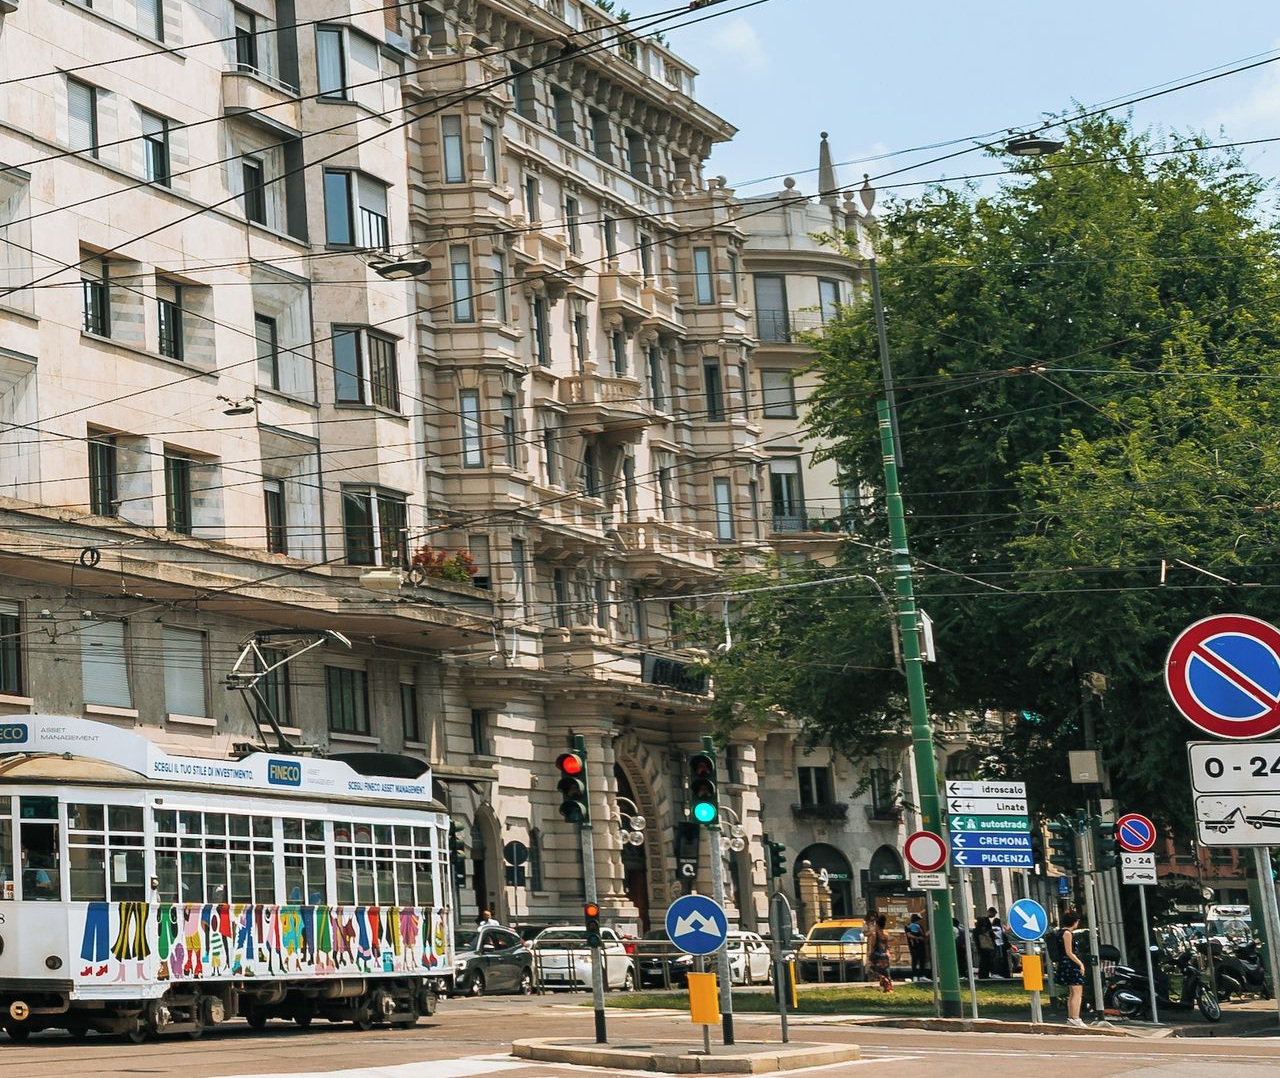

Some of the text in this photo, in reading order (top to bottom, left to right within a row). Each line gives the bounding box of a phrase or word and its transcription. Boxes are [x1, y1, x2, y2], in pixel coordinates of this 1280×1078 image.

[40, 734, 100, 742] MANAGEMENT
[154, 761, 254, 780] SCEGLI IL TUO STILE DI INVESTIMENTO.
[270, 764, 300, 781] FINECO
[348, 781, 363, 791] SCEGLI
[364, 783, 381, 792] FINECO
[381, 784, 394, 793] ASSET
[982, 785, 1024, 794] idroscalo
[996, 802, 1025, 811] Linate
[980, 820, 1027, 829] autostrade
[979, 836, 1029, 846] CREMONA
[981, 853, 1031, 863] PIACENZA
